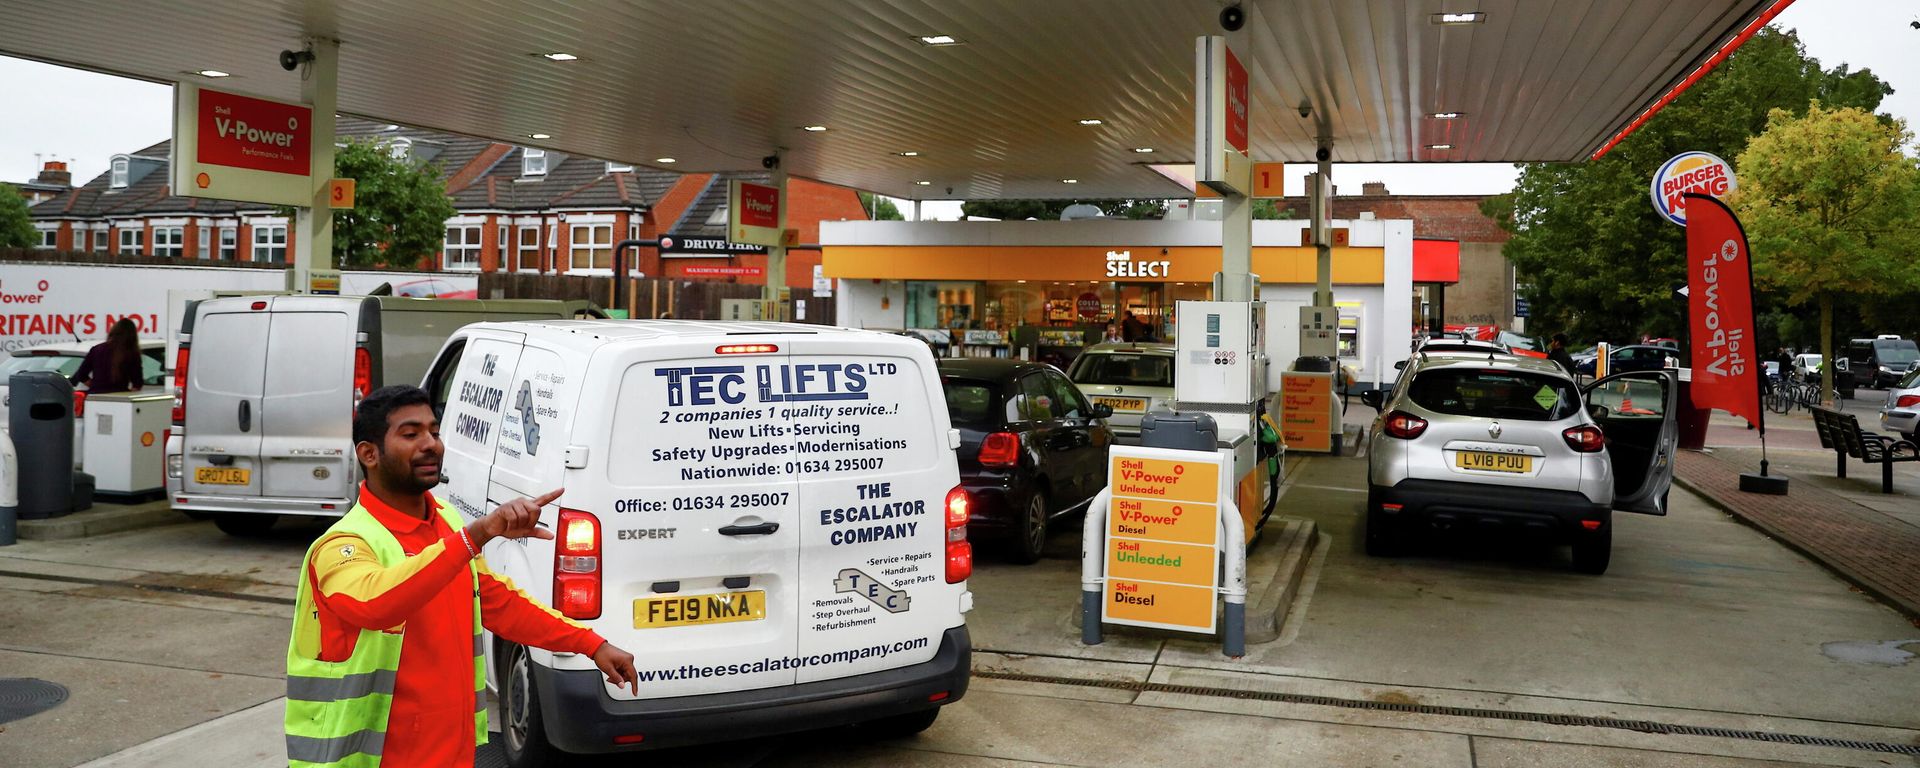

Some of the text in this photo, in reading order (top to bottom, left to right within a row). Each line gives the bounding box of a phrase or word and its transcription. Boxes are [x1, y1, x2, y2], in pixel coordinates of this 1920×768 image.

[215, 105, 231, 115] Shell
[215, 117, 294, 147] V-Power
[242, 147, 279, 159] Performance
[1261, 171, 1270, 189] 1
[1663, 164, 1724, 196] BURGER
[334, 186, 343, 201] 3
[1668, 177, 1728, 214] KNG
[684, 239, 725, 249] DRIVE
[1106, 250, 1130, 261] Shell
[1106, 261, 1170, 277] SELECT
[0, 290, 43, 304] ower
[655, 363, 897, 406] TEC LIFTS LTD
[459, 380, 503, 413] ESCALATOR
[1122, 400, 1141, 409] PYP
[659, 411, 670, 423] 2
[675, 406, 762, 424] companies
[768, 407, 775, 418] 1
[781, 404, 833, 420] quality
[456, 412, 492, 445] COMPANY
[708, 422, 860, 440] New Lifts Servicing
[653, 437, 907, 462] Safety Upgrades Modernisations
[681, 457, 884, 481] Nationwide: 01634 295007
[1121, 460, 1143, 470] Shell
[1463, 454, 1524, 469] LV18 PUU
[198, 469, 224, 482] GR07
[312, 468, 330, 478] GB
[1121, 469, 1179, 484] V-Power
[857, 482, 891, 500] THE
[1120, 484, 1165, 496] Unleaded
[615, 492, 789, 514] Office: 01634 295007
[1119, 501, 1142, 511] Shell
[820, 500, 925, 526] ESCALATOR
[1119, 510, 1178, 526] V-Power
[617, 528, 677, 541] EXPERT
[830, 522, 918, 546] COMPANY
[1118, 525, 1146, 535] Diesel
[1117, 542, 1140, 551] Shell
[870, 551, 932, 566] Service Repairs
[1117, 551, 1182, 568] Unleaded
[884, 565, 919, 576] Handrails
[894, 574, 935, 588] Spare Parts
[1116, 583, 1138, 593] Shell
[815, 597, 853, 608] Removals
[1115, 592, 1155, 606] Diesel
[649, 594, 750, 622] FE19 NKA
[816, 605, 870, 620] Step Overhaul
[816, 617, 876, 632] Refurbishment
[638, 636, 928, 683] ww.theescalatorcompany.com
